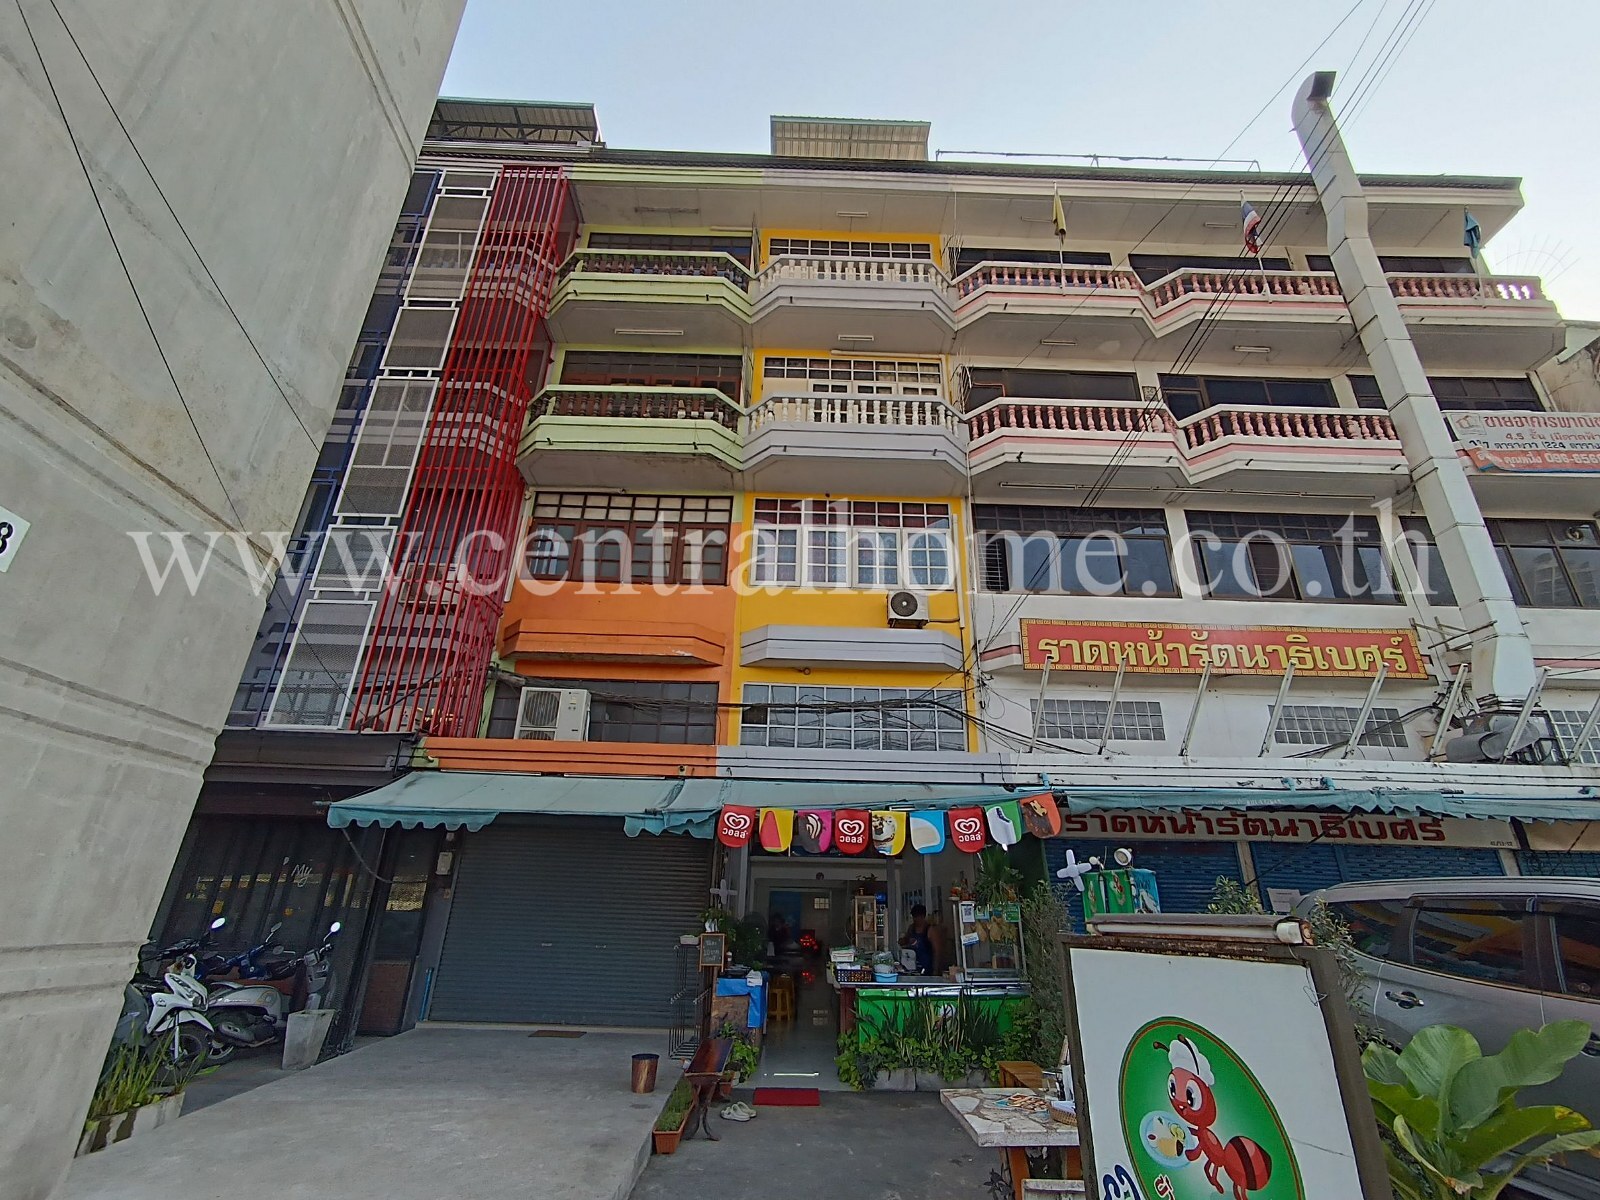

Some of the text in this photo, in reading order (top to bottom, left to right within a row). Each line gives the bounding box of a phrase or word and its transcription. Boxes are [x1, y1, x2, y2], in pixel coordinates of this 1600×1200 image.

[1037, 628, 1408, 672] ราดหน้ารัตนาธิเบศร์
[722, 827, 748, 839] วอลล์
[839, 834, 865, 844] วอลล์
[958, 831, 983, 843] วอลล์
